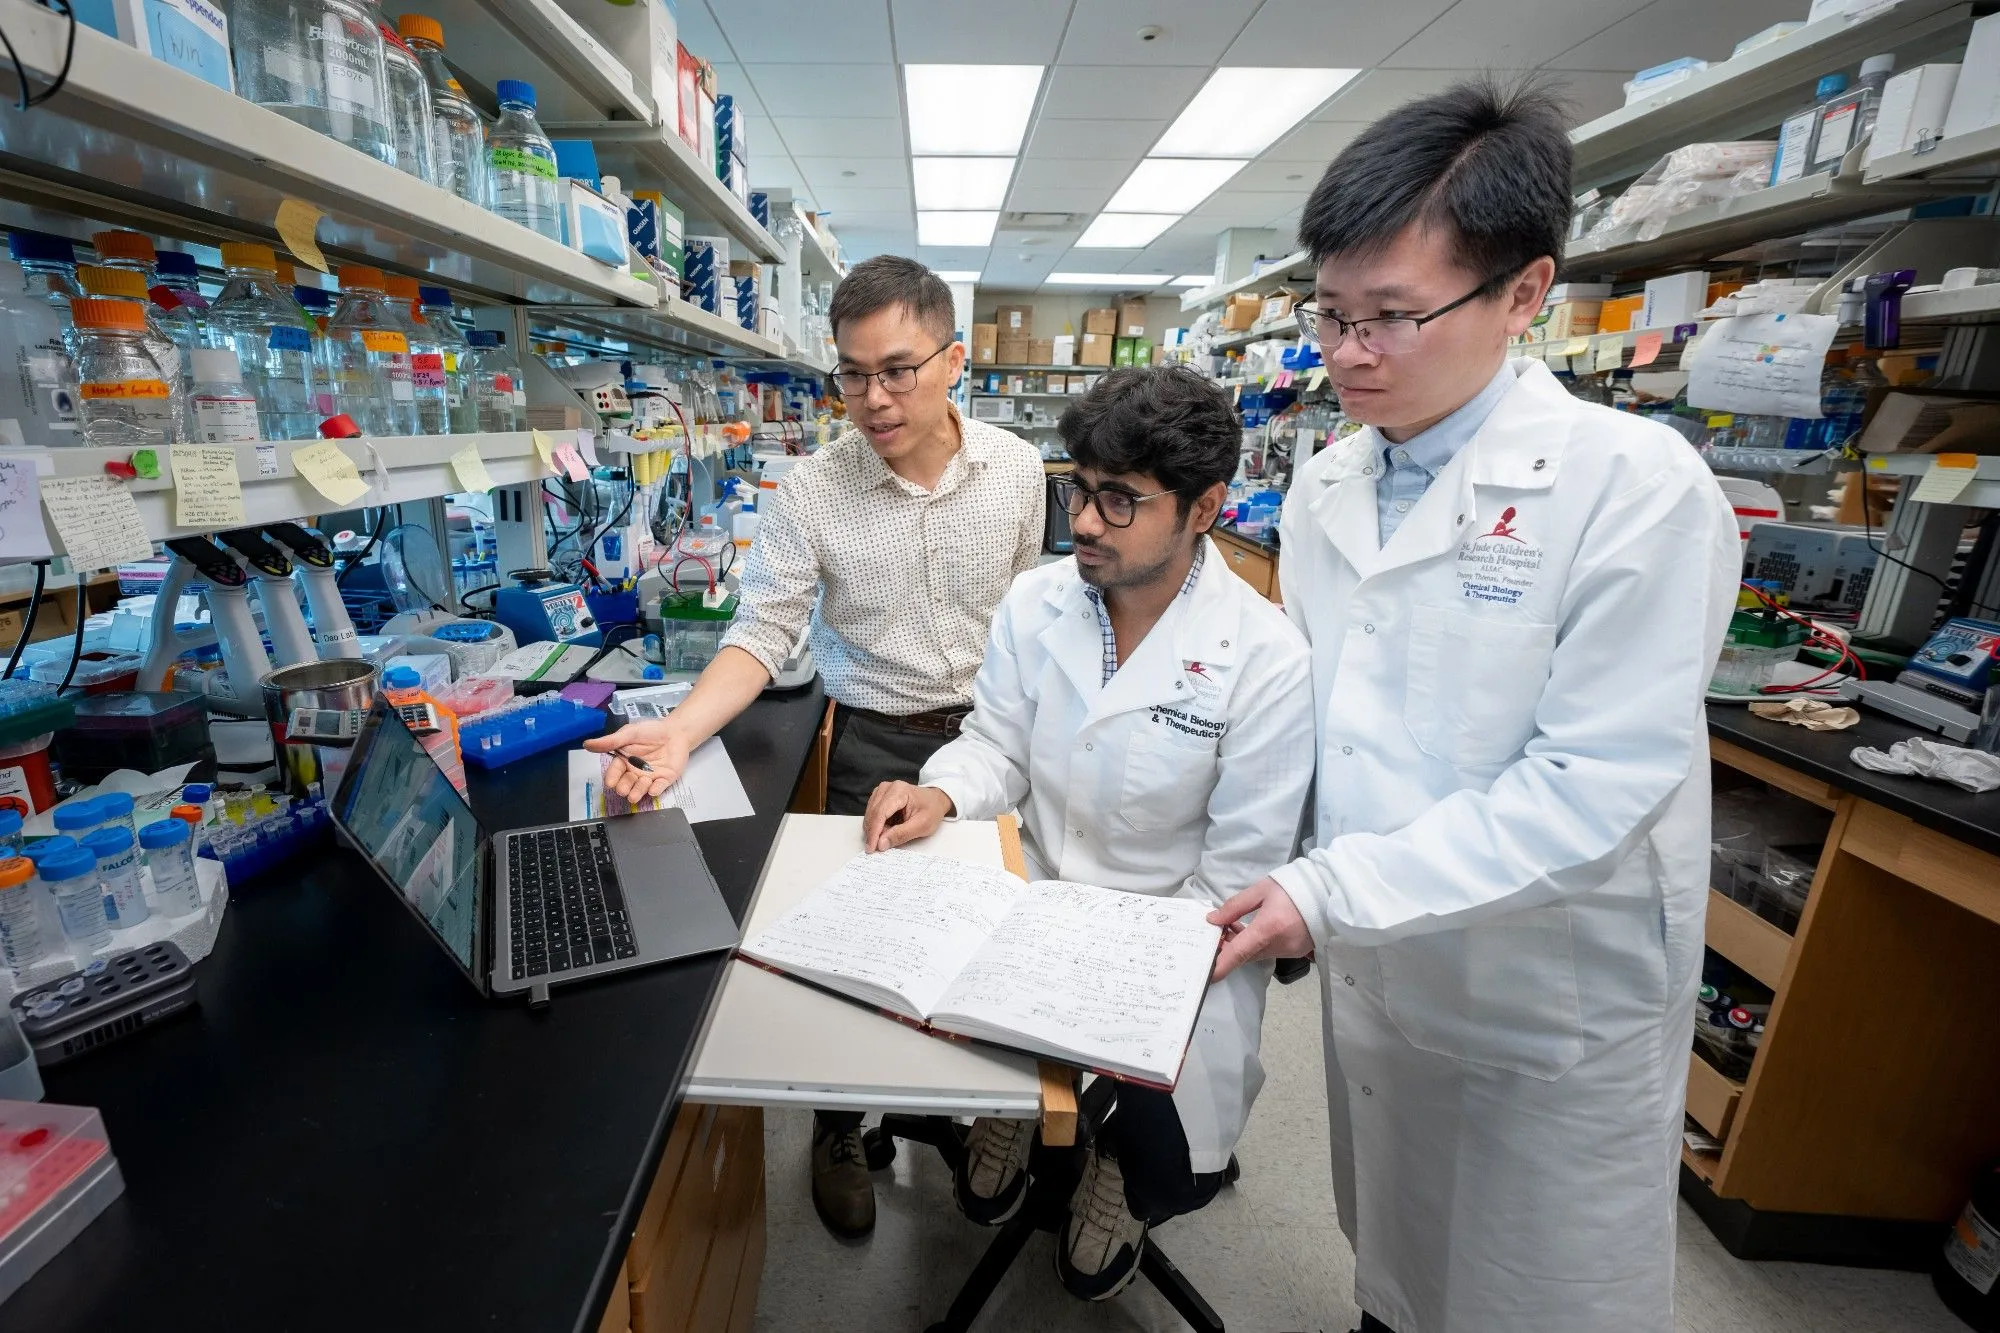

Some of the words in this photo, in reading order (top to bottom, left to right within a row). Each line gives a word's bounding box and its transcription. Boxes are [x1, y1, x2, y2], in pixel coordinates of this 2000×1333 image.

[632, 217, 649, 235] QIAGEN
[1472, 541, 1491, 553] Jude
[1492, 543, 1543, 559] Children's
[1457, 551, 1494, 564] Research
[1496, 555, 1541, 570] Hospital
[1462, 581, 1491, 593] Chemical
[1491, 585, 1524, 599] Biology
[1464, 590, 1471, 598] &
[1472, 590, 1517, 604] Therapeutics
[572, 595, 586, 609] 2
[323, 634, 339, 642] Dao
[340, 630, 355, 640] Lab
[1151, 713, 1160, 724] &
[1164, 716, 1221, 739] Therapeutics
[1189, 714, 1226, 731] Biology
[102, 854, 136, 872] FALCO
